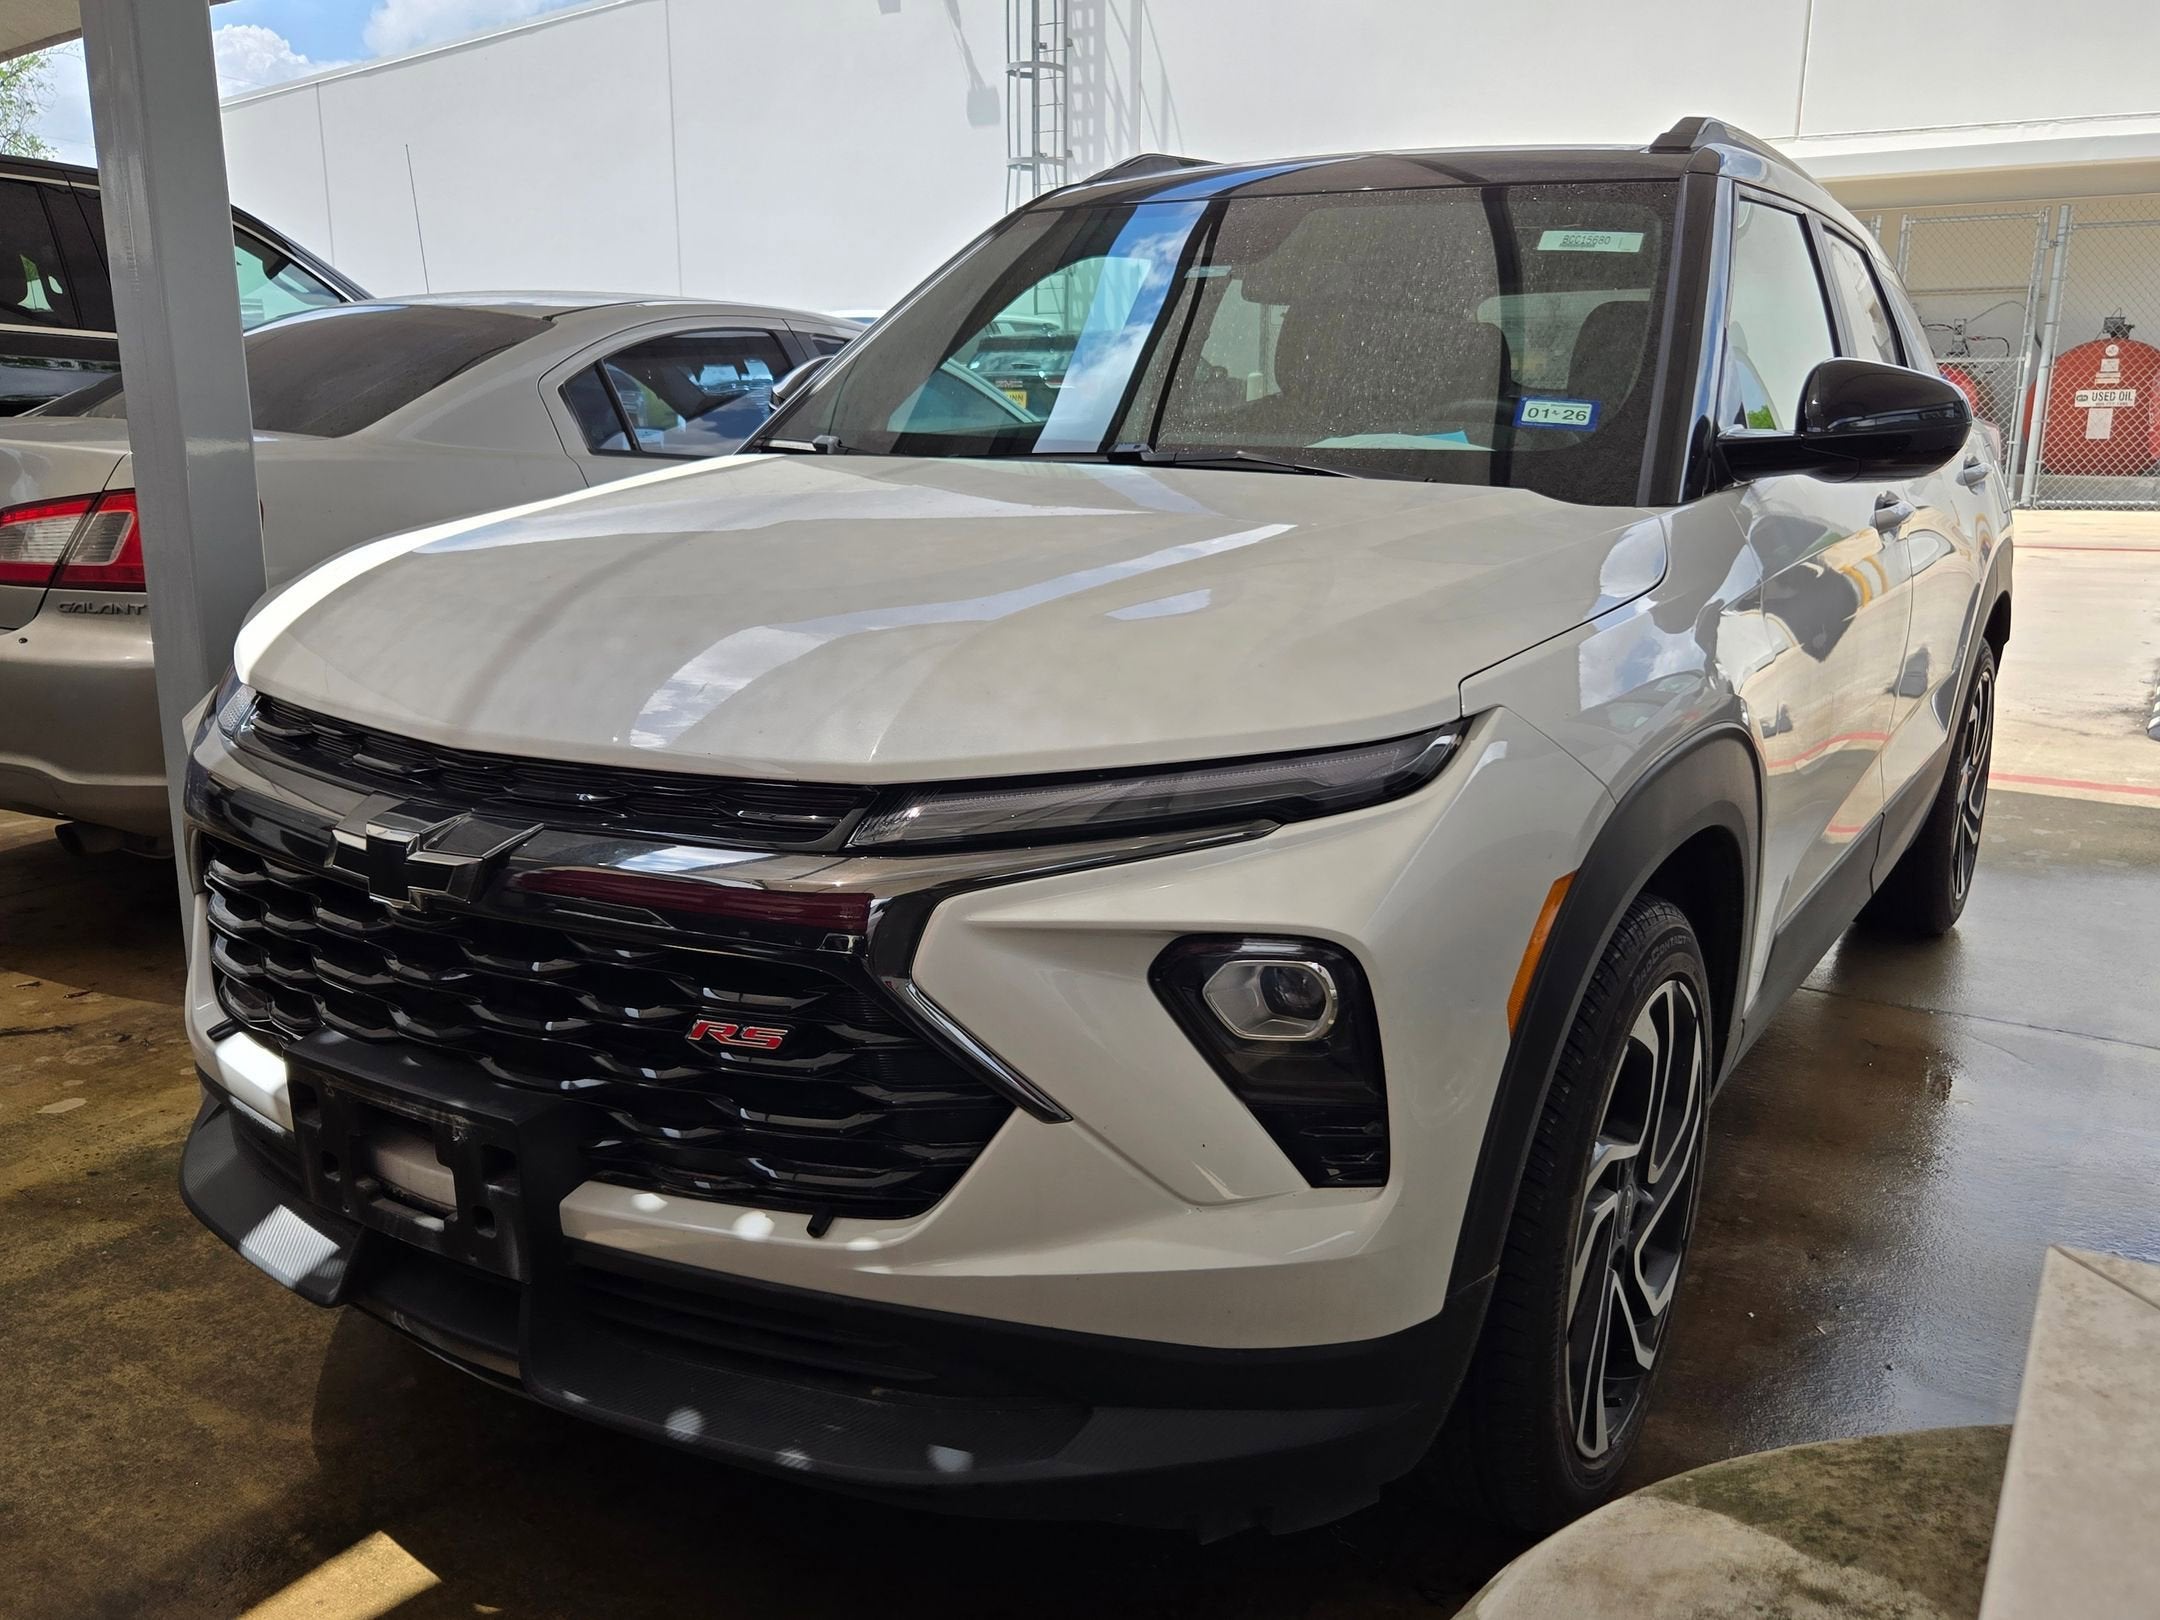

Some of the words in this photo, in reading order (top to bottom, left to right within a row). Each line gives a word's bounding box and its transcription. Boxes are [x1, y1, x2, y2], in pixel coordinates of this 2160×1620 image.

[2091, 391, 2116, 402] USED
[2118, 390, 2133, 402] OIL
[1527, 407, 1550, 419] 01
[1561, 409, 1588, 422] 26
[58, 601, 148, 616] GALANT
[685, 1018, 789, 1051] RS
